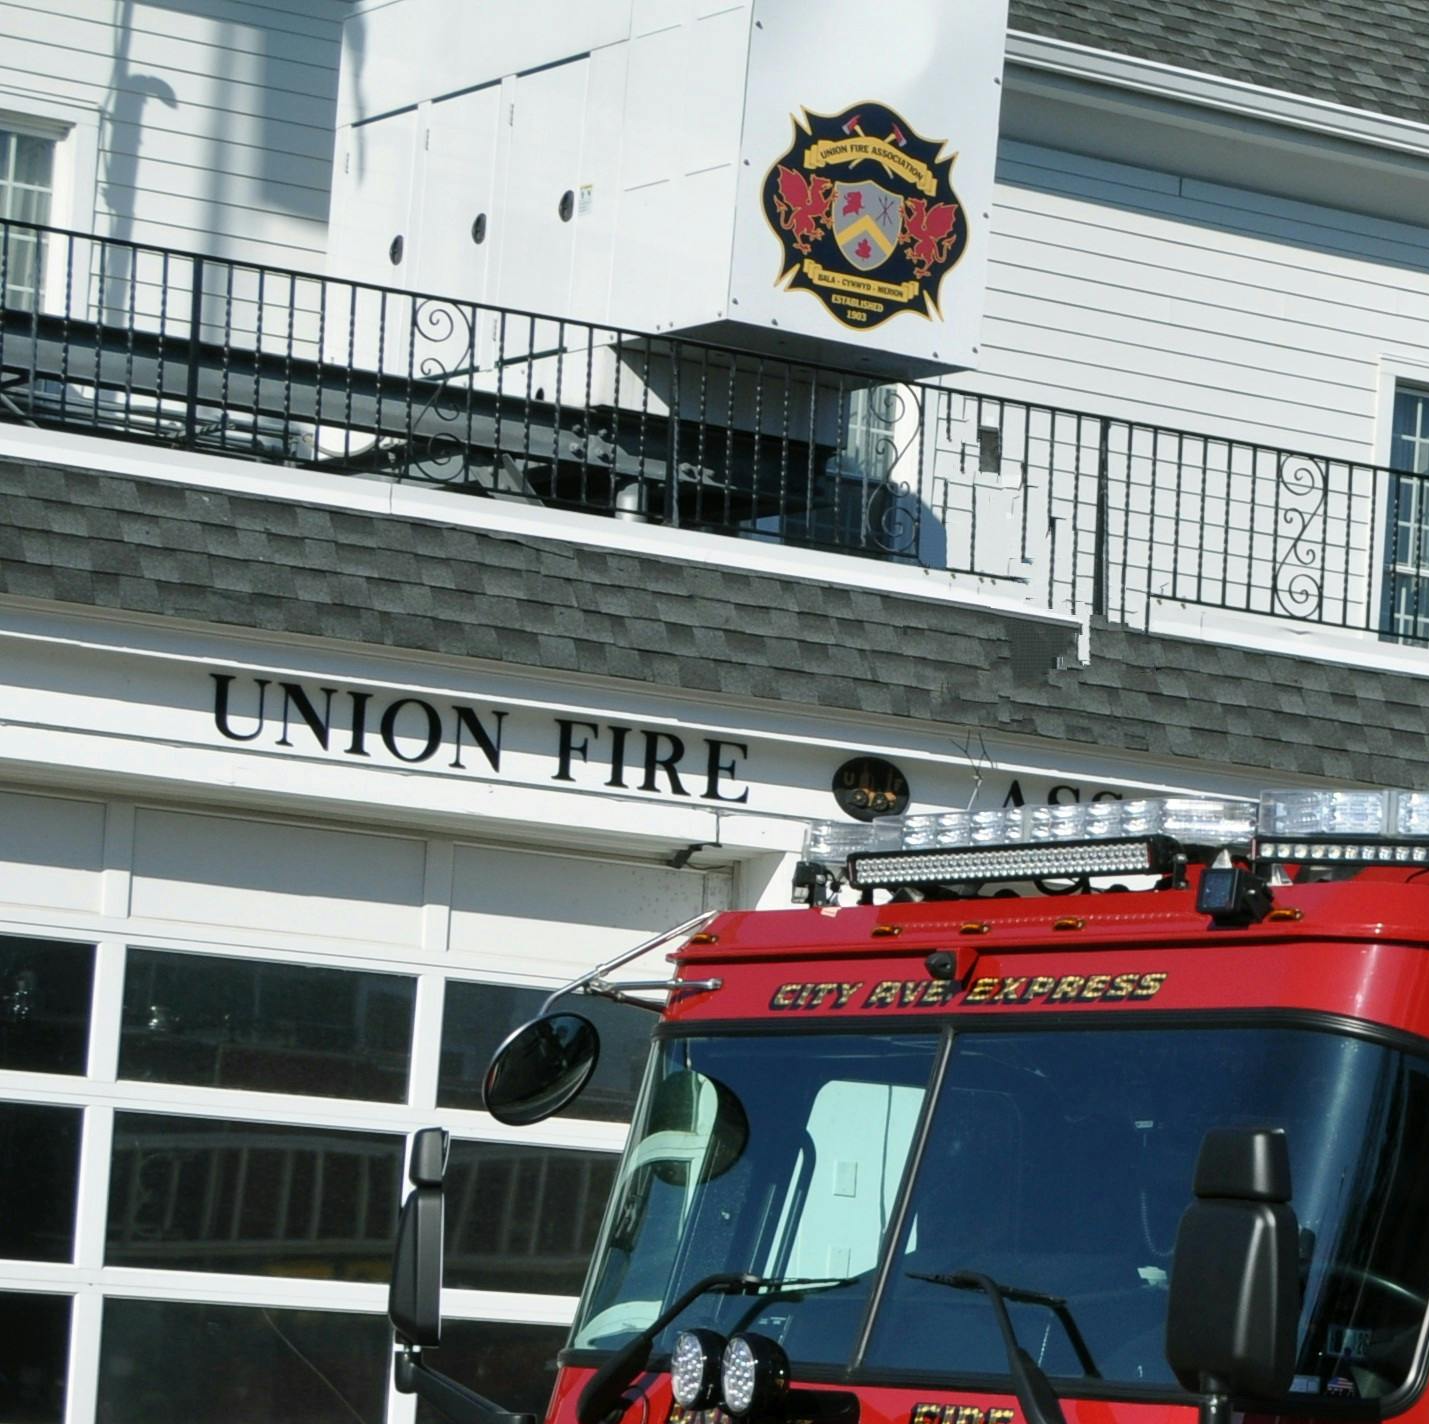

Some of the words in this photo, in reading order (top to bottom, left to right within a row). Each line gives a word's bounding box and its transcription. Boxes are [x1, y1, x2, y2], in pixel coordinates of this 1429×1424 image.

[820, 144, 848, 160] UNION
[850, 143, 868, 154] FIRE
[871, 145, 924, 180] ASSOCIATION
[831, 294, 884, 313] ESTABLISHED
[210, 673, 508, 774] UNION
[552, 717, 749, 805] FIRE
[769, 980, 864, 1011] CITY
[961, 971, 1168, 1007] EXPRESS
